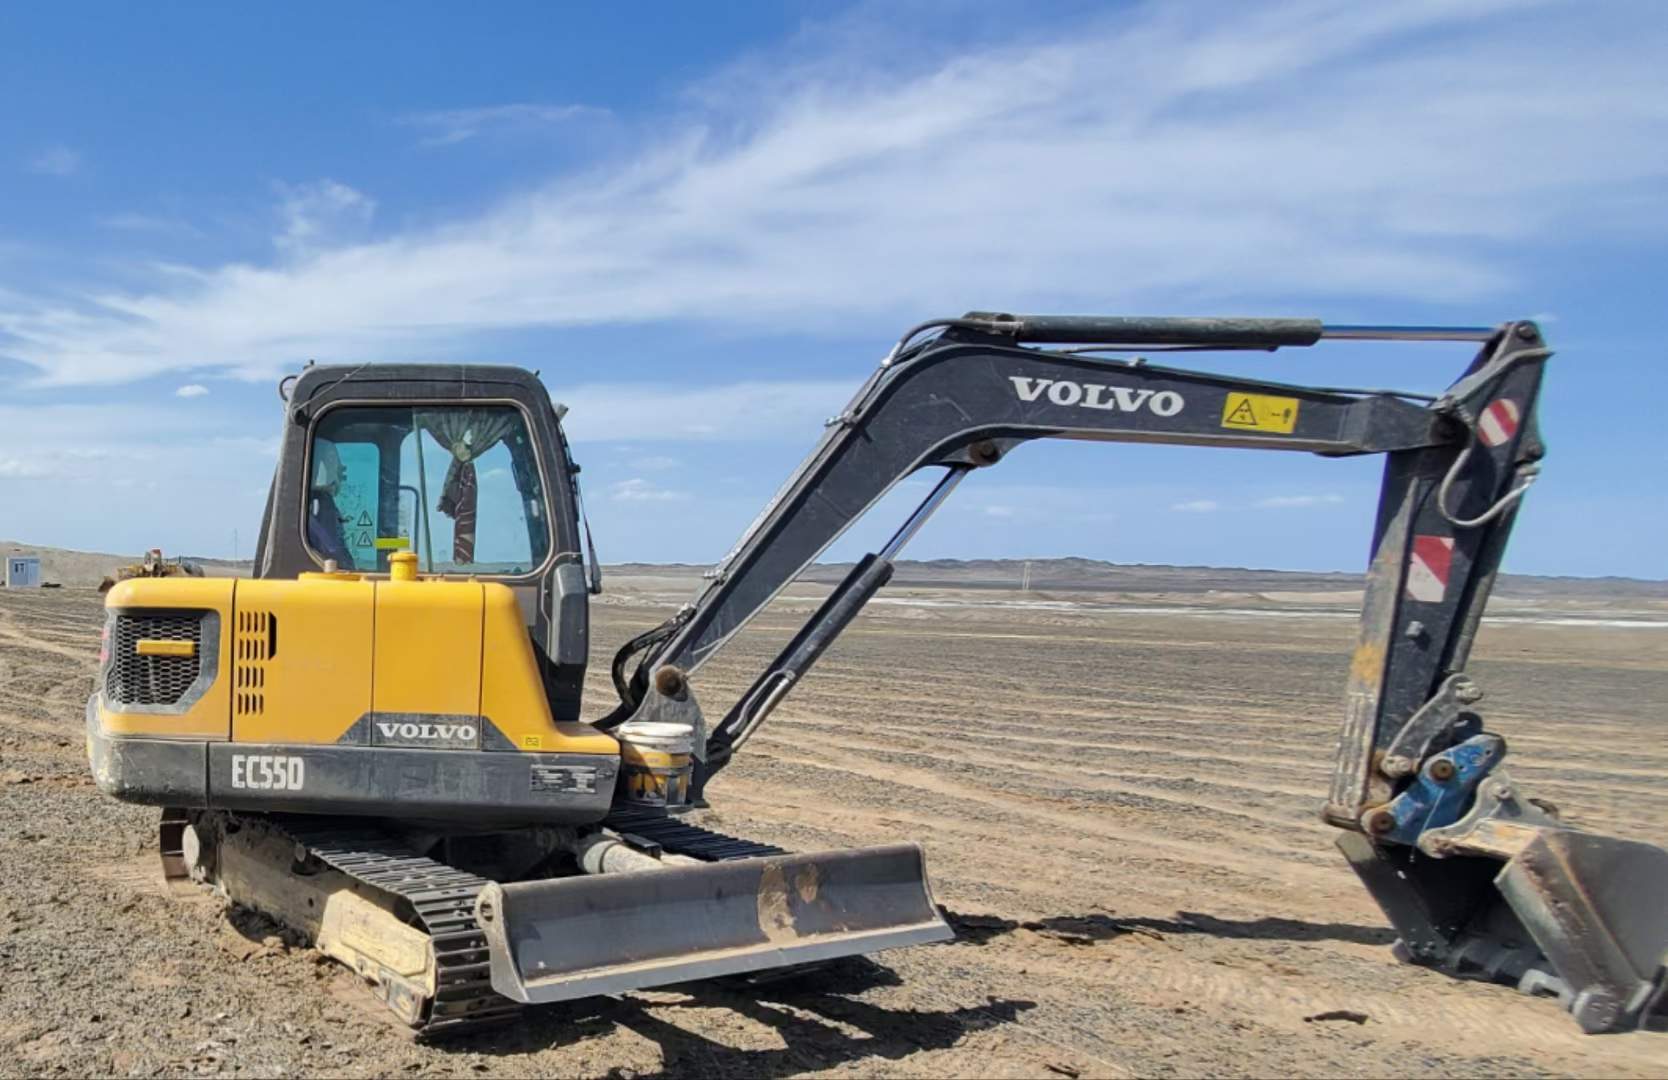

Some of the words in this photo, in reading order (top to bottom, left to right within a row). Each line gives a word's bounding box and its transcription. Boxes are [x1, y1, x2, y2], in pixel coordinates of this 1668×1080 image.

[1009, 375, 1185, 416] VOLVO
[376, 721, 477, 741] VOLVO
[231, 754, 305, 790] EC55D
